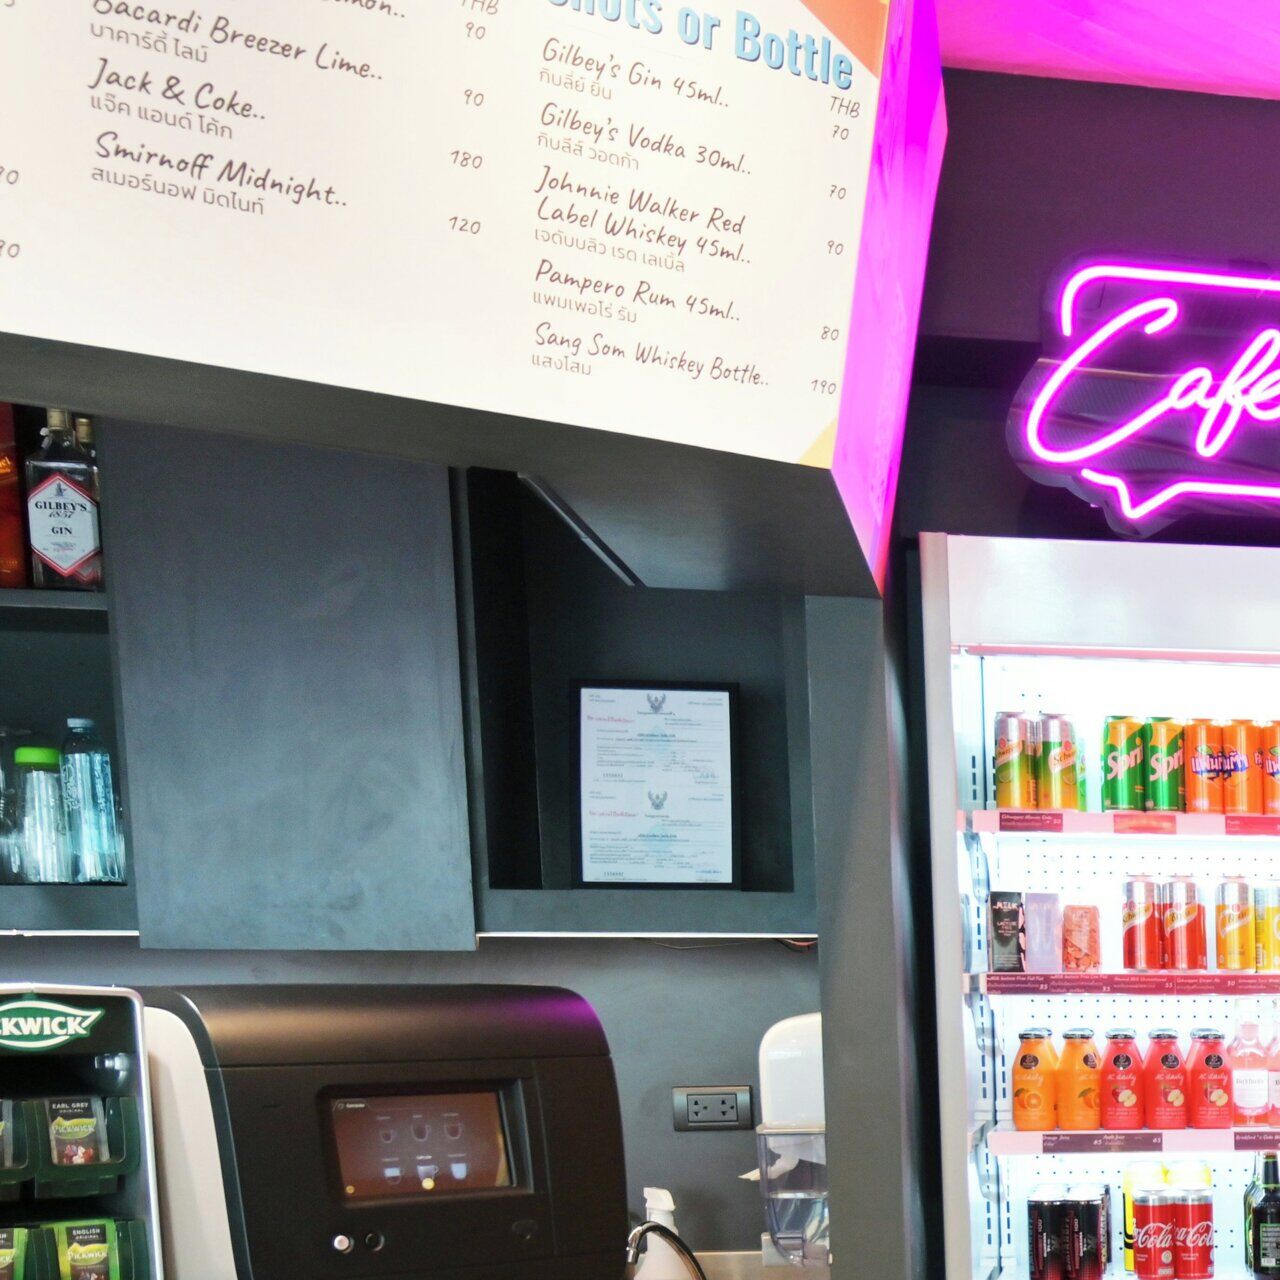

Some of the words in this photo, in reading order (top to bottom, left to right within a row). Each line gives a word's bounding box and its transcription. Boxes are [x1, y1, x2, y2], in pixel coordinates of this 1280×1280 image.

[210, 16, 306, 59] Breezer
[465, 22, 486, 40] 90
[677, 6, 720, 51] or
[735, 10, 853, 91] Bottle
[542, 38, 621, 80] Gilbey's
[628, 62, 661, 90] Gin
[88, 57, 151, 95] Jack
[162, 76, 185, 106] &
[195, 83, 265, 119] Coke..
[464, 89, 484, 106] 90
[138, 105, 192, 130] แอนด์
[829, 96, 861, 118] THB
[540, 103, 618, 144] Gilbey's
[629, 123, 686, 158] Vodka
[832, 125, 849, 140] 70
[96, 131, 213, 179] Smirnoff
[217, 159, 346, 206] Midnight..
[450, 150, 483, 169] 180
[535, 165, 619, 205] Johnnie
[628, 189, 700, 223] Walker
[707, 207, 746, 234] Red
[829, 184, 846, 200] 70
[449, 216, 480, 235] 120
[537, 196, 597, 229] Label
[605, 212, 686, 256] Whiskey
[827, 241, 844, 255] 90
[535, 259, 625, 298] Pampero
[633, 280, 675, 308] Rum
[821, 326, 839, 341] 80
[535, 322, 581, 356] Sang
[588, 333, 625, 359] Som
[636, 342, 703, 379] Whiskey
[710, 356, 769, 386] Bottle..
[810, 379, 836, 395] 190
[34, 500, 88, 512] GILBEY'S
[50, 526, 73, 536] GIN
[1106, 746, 1144, 780] Spri
[1149, 748, 1184, 781] Spri
[0, 1016, 87, 1035] KWICK
